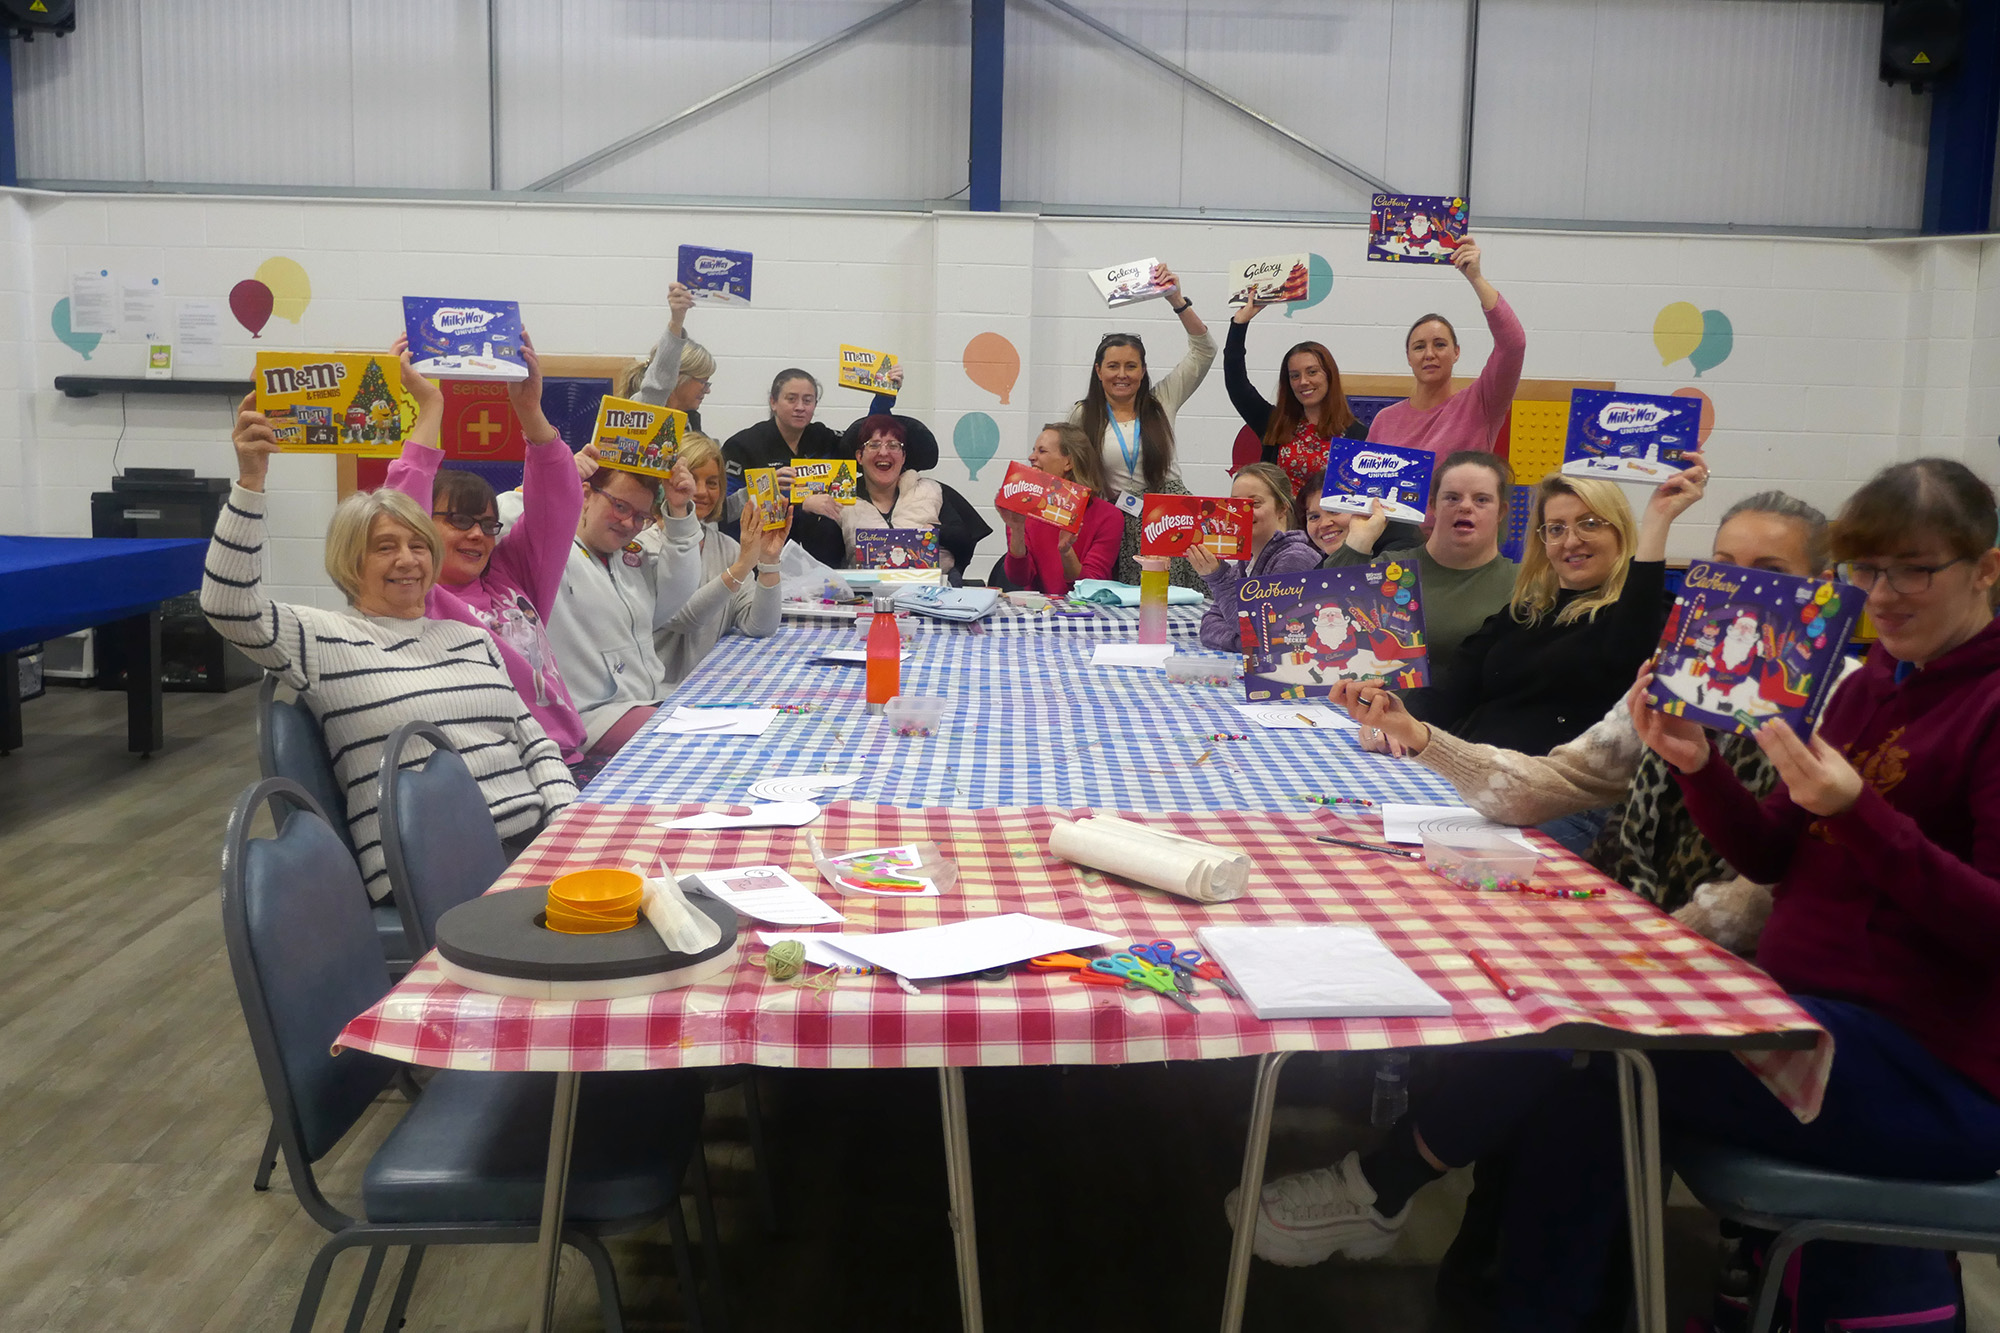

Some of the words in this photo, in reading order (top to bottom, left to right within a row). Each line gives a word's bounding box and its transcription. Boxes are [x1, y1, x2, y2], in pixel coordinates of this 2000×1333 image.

[1373, 195, 1409, 210] Cadbury
[1107, 267, 1140, 282] Galaxy
[1243, 262, 1282, 279] Galaxy
[455, 326, 487, 336] UNIVERSE
[313, 389, 341, 400] FRIENDS
[1620, 425, 1658, 434] UNIVERSE
[1003, 480, 1044, 499] Maltesers
[1144, 514, 1194, 544] Maltesers
[1240, 579, 1304, 601] Cadbury
[1685, 564, 1741, 600] Cadbury
